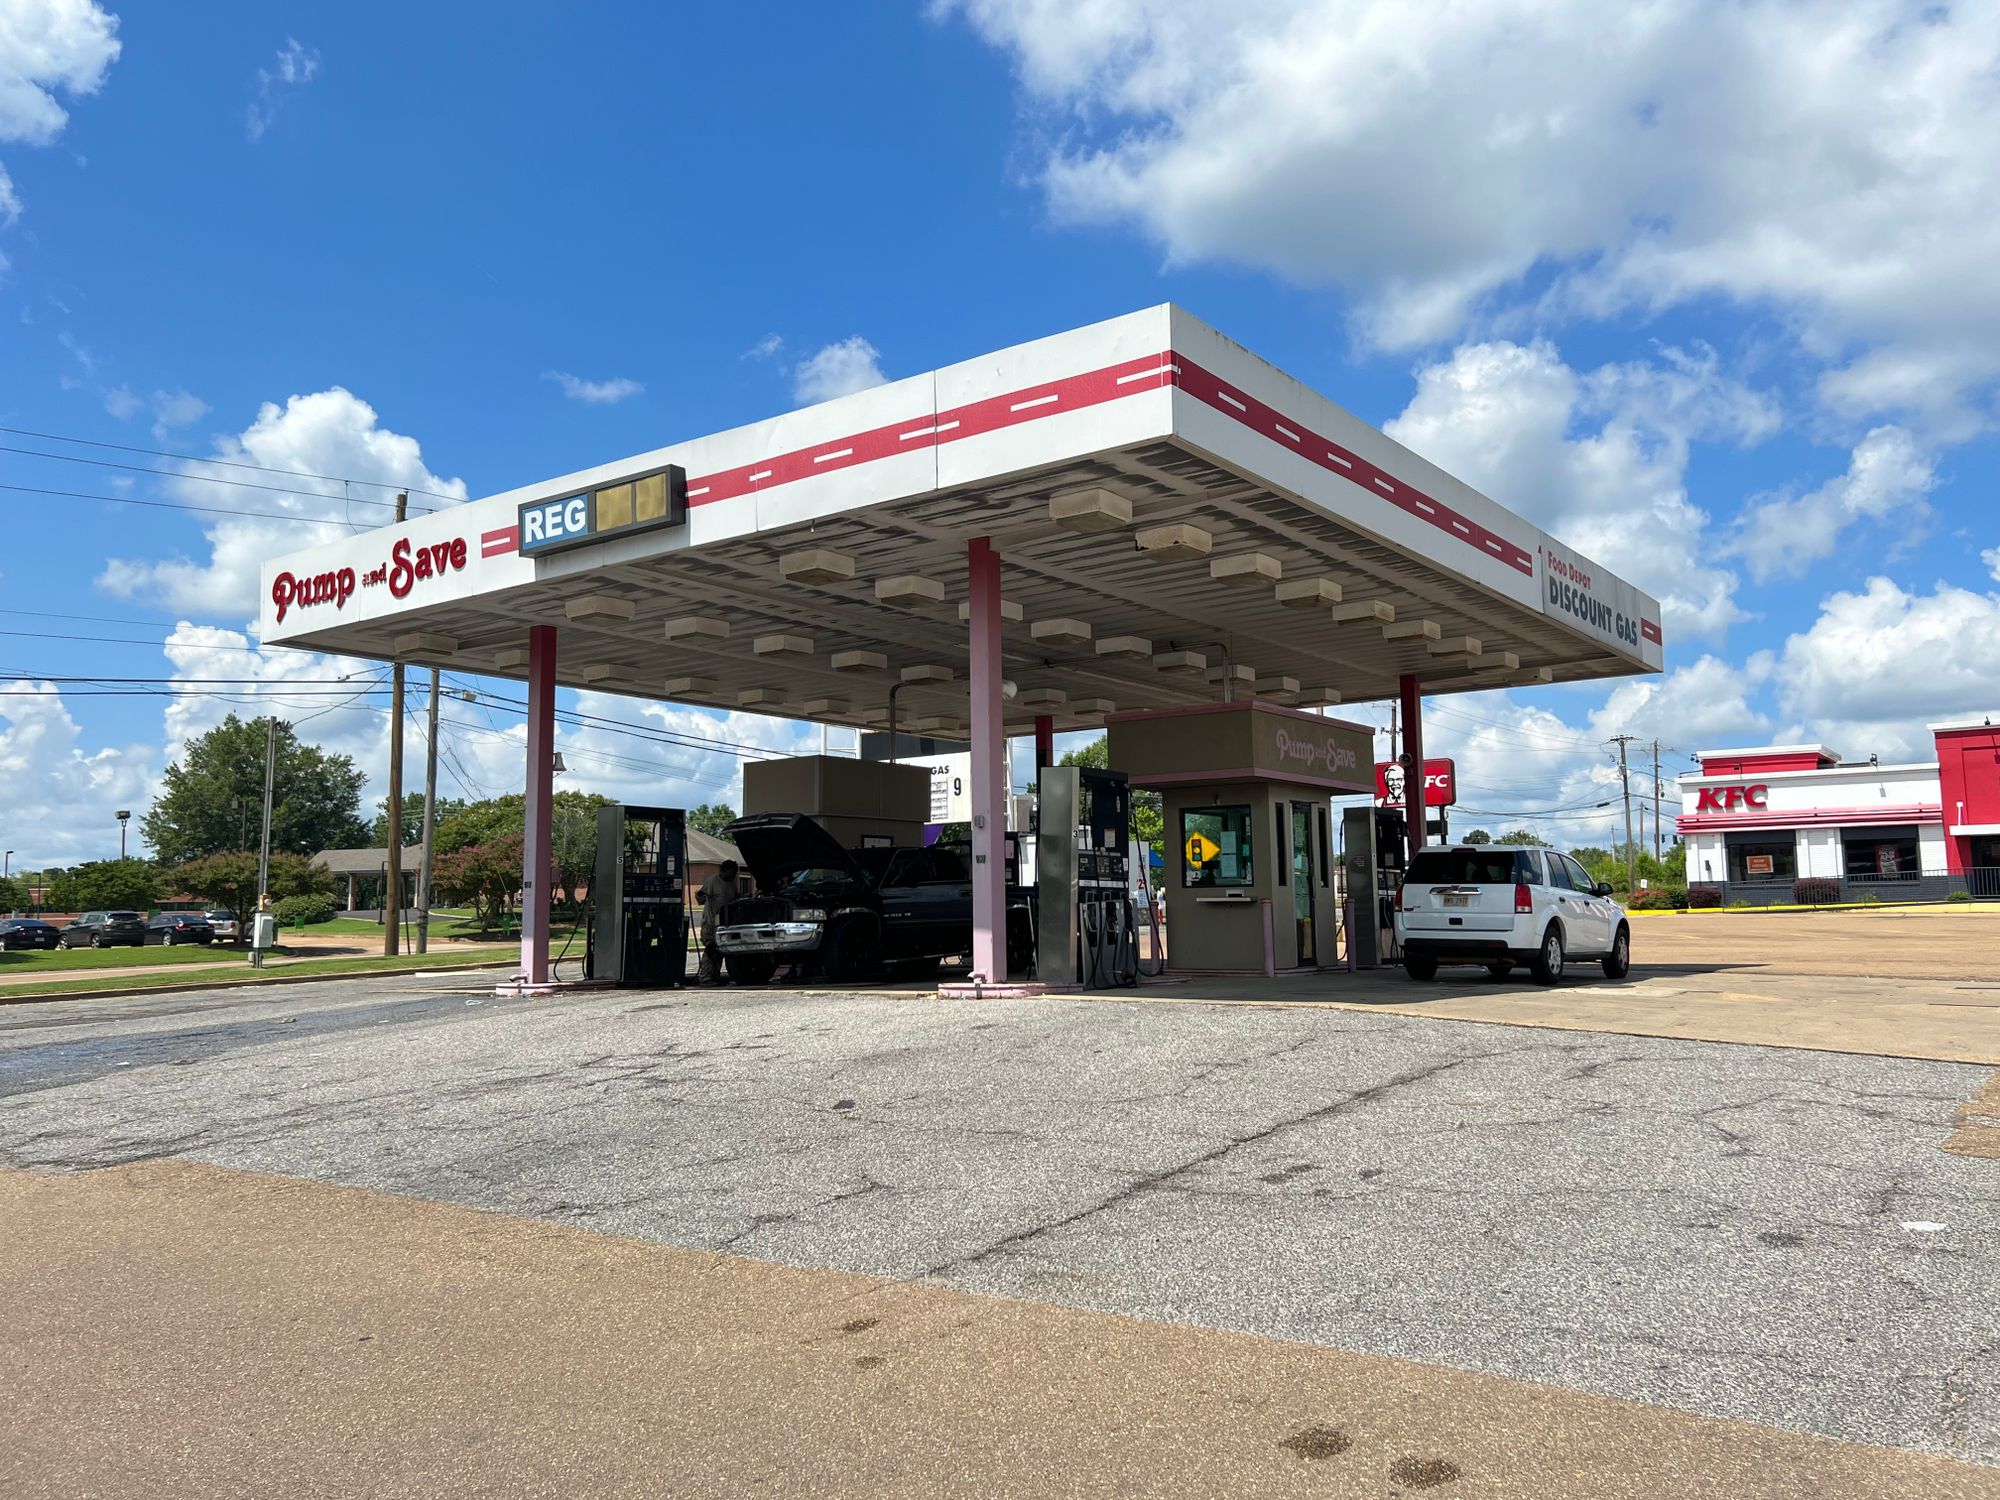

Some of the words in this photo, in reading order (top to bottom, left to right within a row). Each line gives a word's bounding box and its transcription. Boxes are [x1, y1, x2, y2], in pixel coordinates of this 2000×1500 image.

[524, 499, 586, 543] REG
[272, 567, 355, 623] Pump
[362, 562, 387, 586] and
[389, 537, 467, 598] Save
[1547, 551, 1567, 576] FOOD
[1569, 563, 1591, 590] DEPOT
[1549, 575, 1612, 633] DISCOUNT
[1615, 612, 1638, 646] GAS
[1276, 728, 1315, 767] Pump
[1326, 738, 1356, 772] Save
[930, 765, 950, 775] GAS
[953, 777, 962, 797] 9
[1423, 774, 1448, 788] FC
[1696, 784, 1768, 809] KFC
